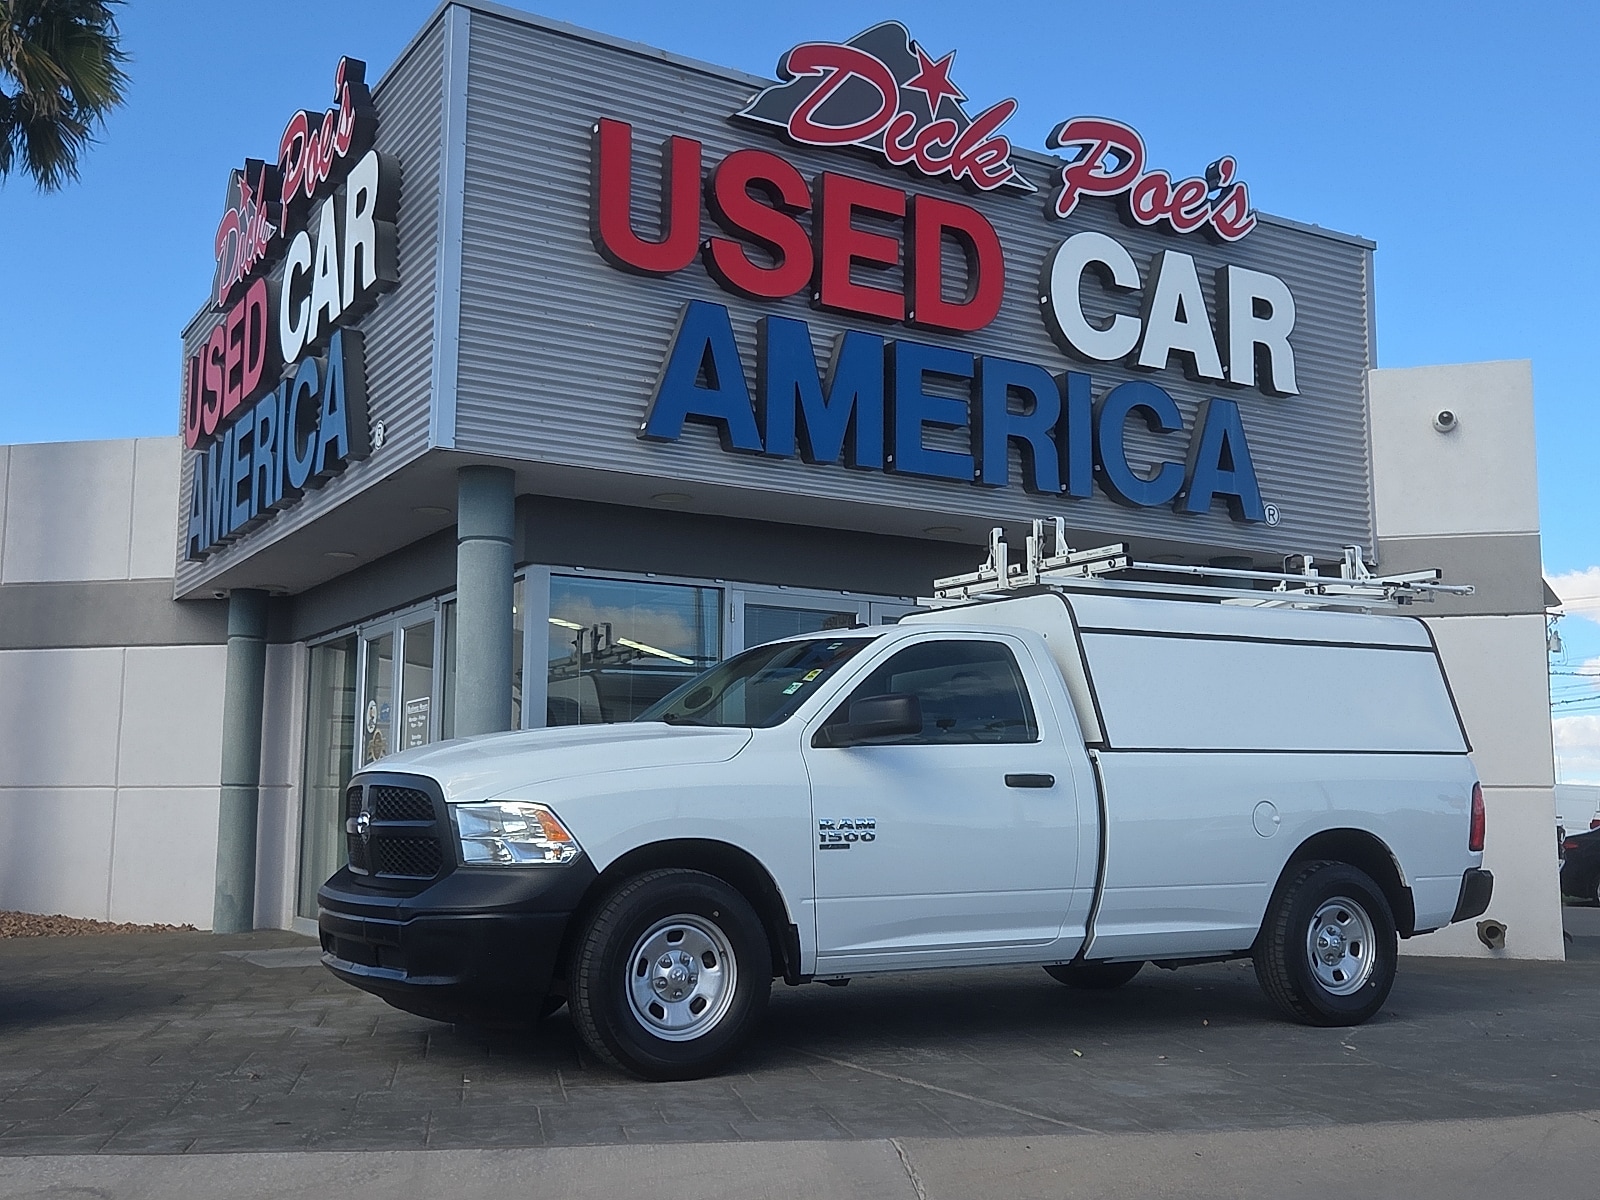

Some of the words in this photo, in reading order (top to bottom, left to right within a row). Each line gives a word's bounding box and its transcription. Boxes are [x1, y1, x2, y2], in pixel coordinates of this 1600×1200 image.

[214, 163, 269, 308] Dick
[277, 56, 357, 239] Poe's
[786, 41, 1019, 191] Dick
[1056, 116, 1258, 242] Poe's
[185, 277, 267, 449] USED
[280, 150, 379, 364] CAR
[598, 117, 1005, 334] USED
[1049, 231, 1299, 396] CAR
[185, 329, 348, 562] AMERICA
[645, 300, 1266, 523] AMERICA
[819, 818, 876, 830] RAM
[819, 831, 876, 842] 1500
